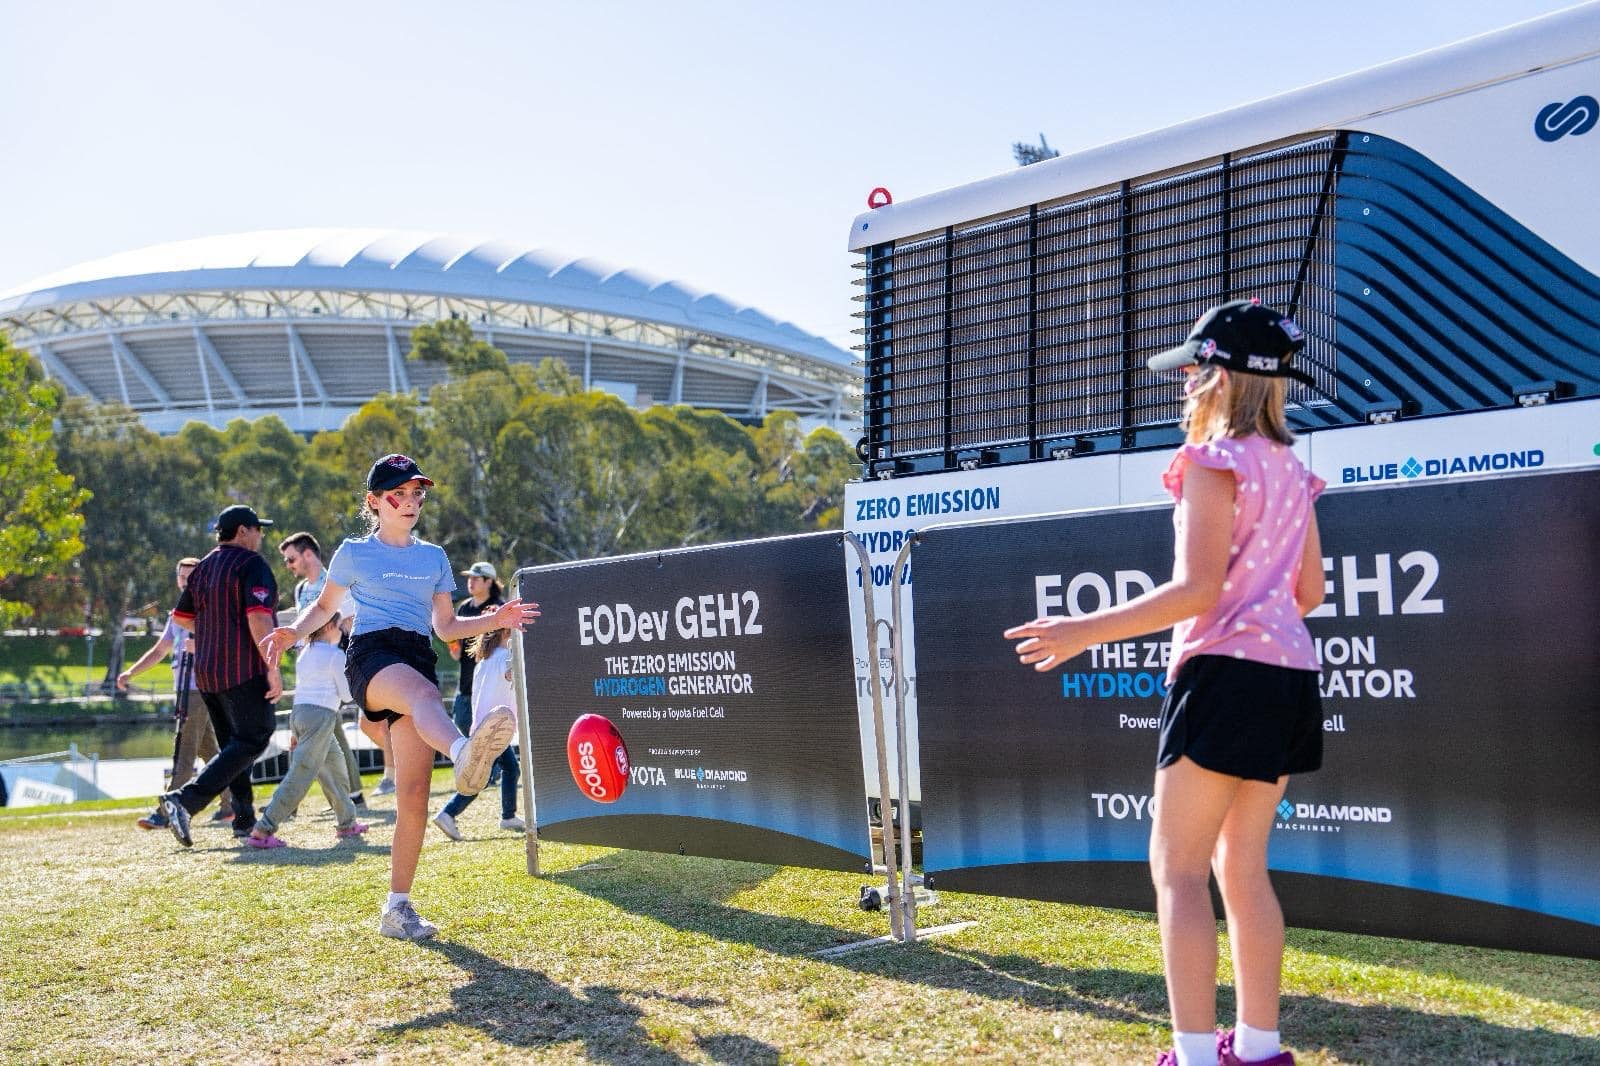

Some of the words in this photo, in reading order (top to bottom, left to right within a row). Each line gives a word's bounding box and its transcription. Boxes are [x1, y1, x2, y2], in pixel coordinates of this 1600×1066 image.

[1342, 463, 1398, 484] BLUE
[1425, 450, 1544, 476] DIAMOND
[856, 497, 901, 521] ZERO
[906, 486, 1000, 517] EMISSION
[1035, 569, 1156, 618] EOD
[1304, 550, 1444, 617] EH2
[578, 603, 669, 646] EODev
[675, 591, 763, 640] GEH2
[605, 656, 629, 675] THE
[631, 655, 665, 674] ZERO
[668, 651, 736, 673] EMISSION
[1086, 642, 1137, 668] THE
[1143, 642, 1171, 667] ZE
[593, 676, 666, 697] HYDROGEN
[668, 673, 754, 696] GENERATOR
[622, 707, 652, 719] Powered
[652, 708, 661, 720] by
[668, 707, 692, 721] Toyota
[692, 706, 708, 719] Fuel
[709, 706, 725, 718] Cell
[1119, 713, 1161, 729] Power
[1321, 714, 1346, 732] ell
[578, 741, 607, 798] coles
[629, 766, 667, 786] YOTA
[674, 768, 697, 780] BLUE
[704, 768, 747, 782] DIAMOND
[1295, 803, 1392, 823] DIAMOND
[1276, 823, 1341, 833] MACHINERY
